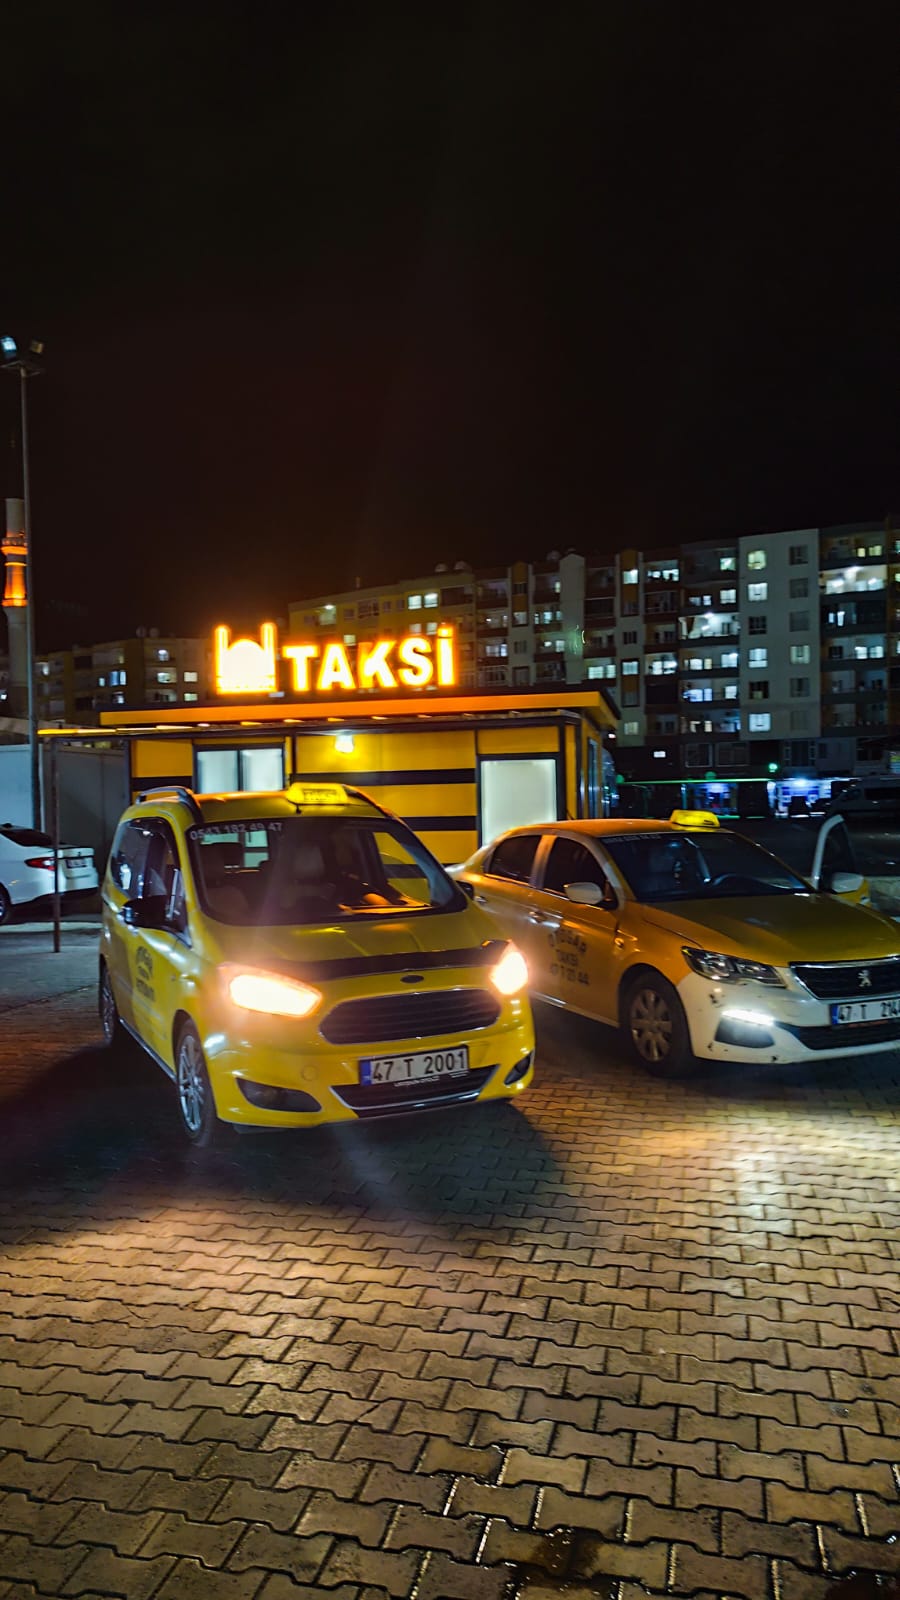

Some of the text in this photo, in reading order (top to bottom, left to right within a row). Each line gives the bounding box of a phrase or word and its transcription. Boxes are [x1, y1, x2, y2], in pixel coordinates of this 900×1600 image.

[281, 624, 456, 692] TAKSİ
[268, 822, 283, 831] 47
[838, 1000, 900, 1021] 47 T 214
[373, 1050, 465, 1081] 47 T 2001
